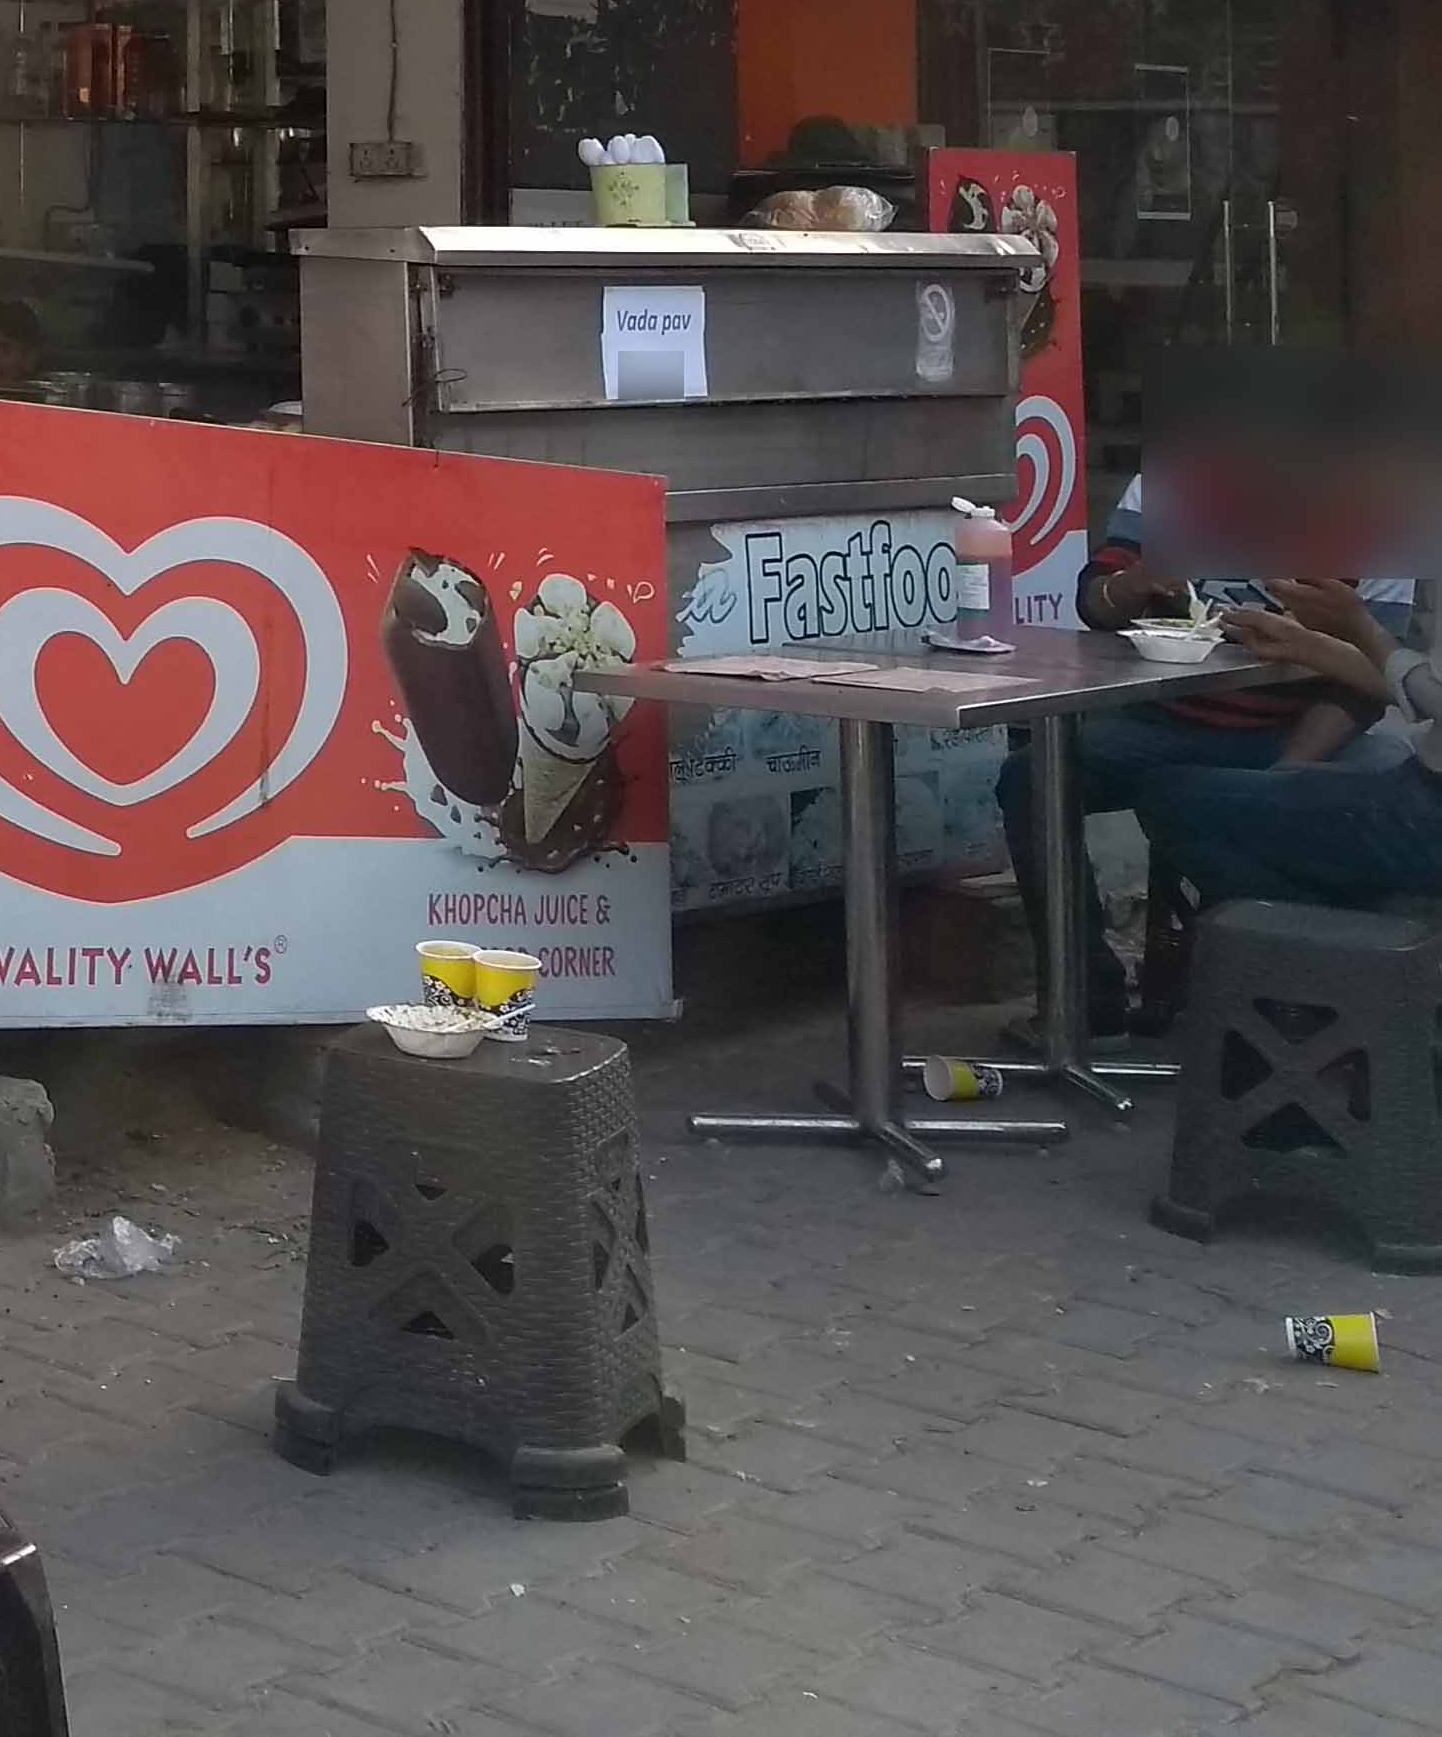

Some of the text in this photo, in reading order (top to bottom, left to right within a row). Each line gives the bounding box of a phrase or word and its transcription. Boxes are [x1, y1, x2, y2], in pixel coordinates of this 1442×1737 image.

[617, 308, 692, 335] Vada pav
[744, 519, 957, 644] Fastfoo
[1015, 594, 1064, 626] LITY
[427, 893, 612, 927] KHOPCHA JUICE &
[145, 943, 273, 986] WALL'S
[539, 947, 617, 978] CORNER
